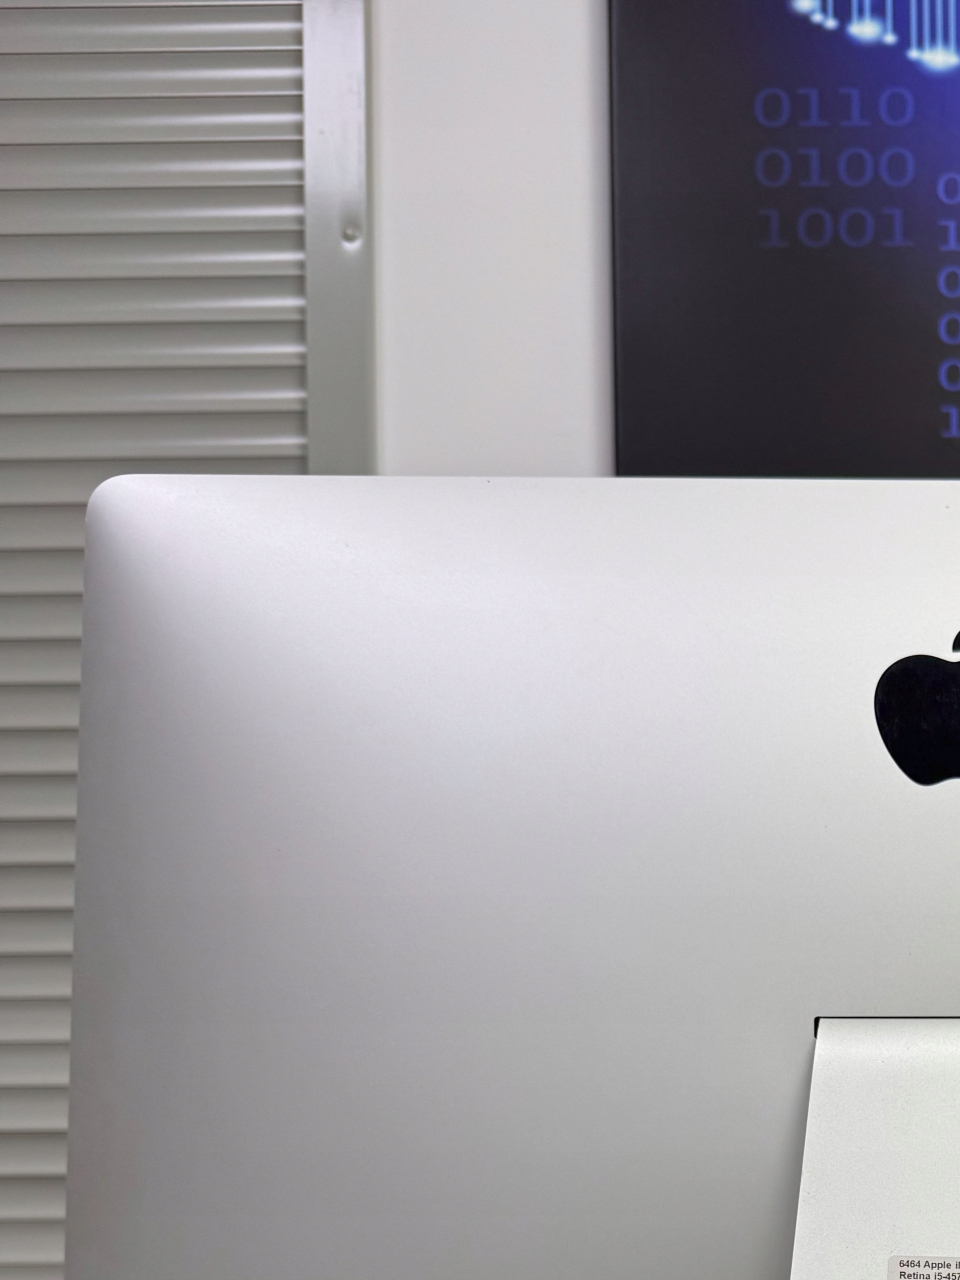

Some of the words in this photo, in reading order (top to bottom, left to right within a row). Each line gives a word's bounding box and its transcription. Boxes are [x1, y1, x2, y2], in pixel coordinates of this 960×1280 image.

[753, 87, 915, 128] 0110
[754, 147, 915, 188] 0100
[757, 207, 915, 249] 1001
[899, 1260, 921, 1268] 6464
[923, 1260, 952, 1271] Apple
[899, 1271, 931, 1280] Retina
